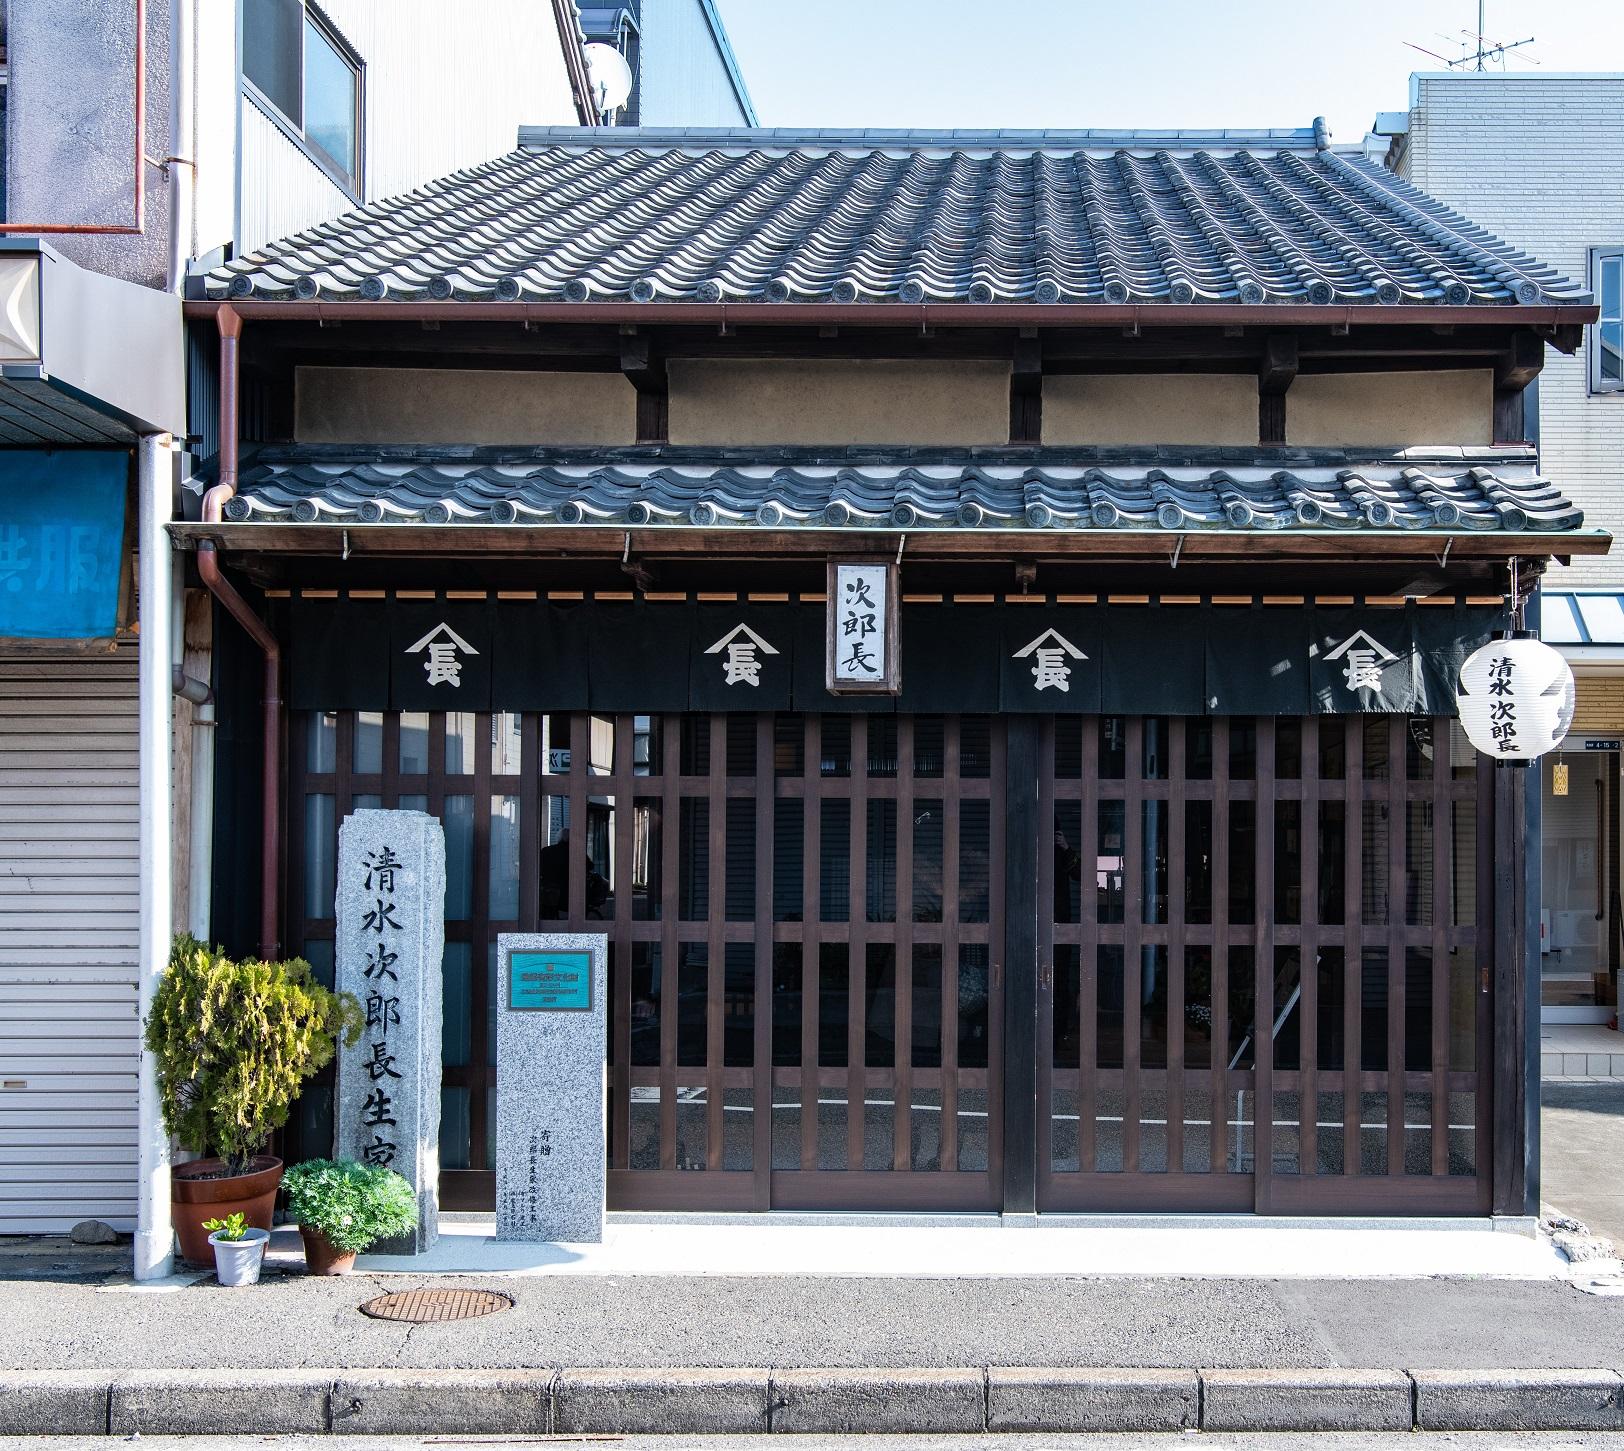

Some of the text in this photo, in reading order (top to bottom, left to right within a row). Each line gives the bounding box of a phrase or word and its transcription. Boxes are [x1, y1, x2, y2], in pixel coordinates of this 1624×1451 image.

[842, 578, 877, 672] 次郎長
[424, 643, 462, 687] 長
[723, 643, 761, 687] 長
[1031, 648, 1071, 692] 長
[1343, 649, 1384, 693] 長
[1488, 656, 1521, 752] 清水次郎長
[540, 1129, 551, 1156] 寄贈
